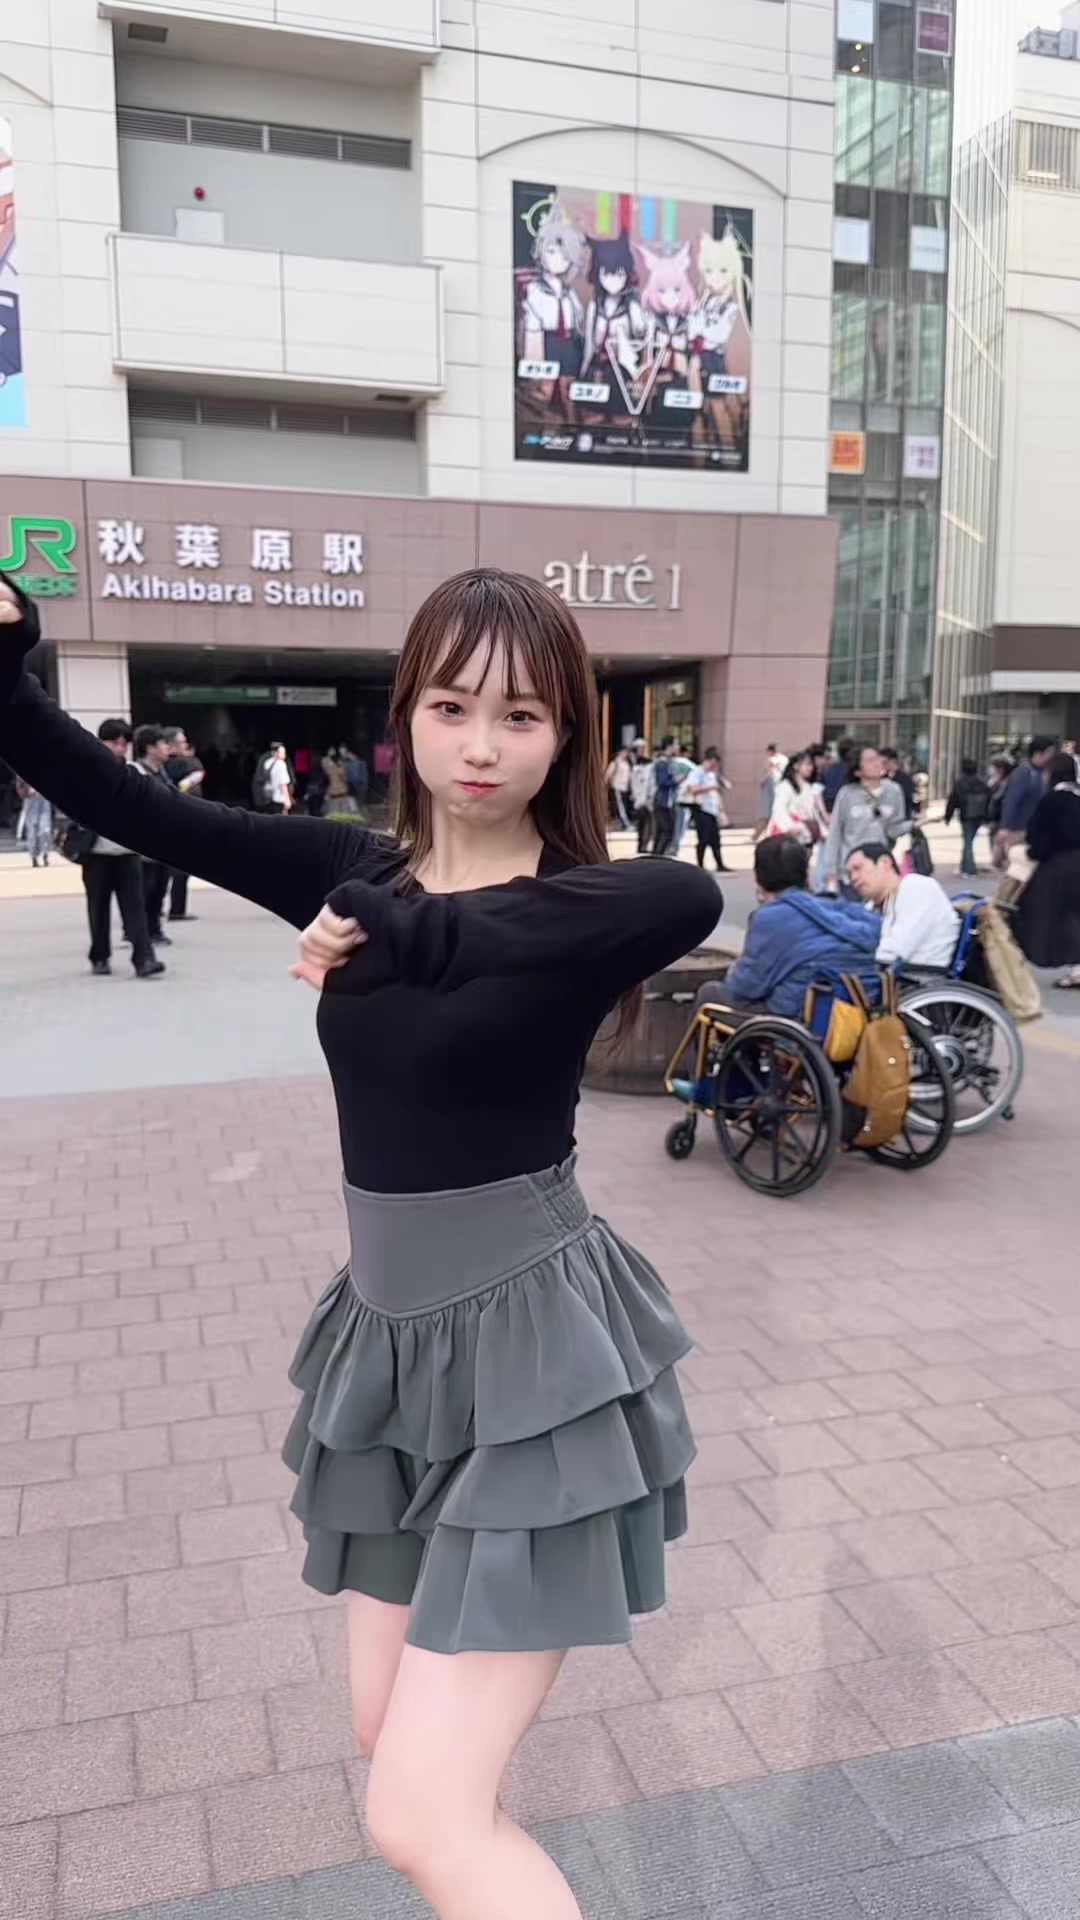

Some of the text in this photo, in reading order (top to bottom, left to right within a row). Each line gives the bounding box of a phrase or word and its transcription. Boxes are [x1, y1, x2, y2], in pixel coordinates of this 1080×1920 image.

[0, 515, 77, 573] JR
[98, 519, 364, 575] 秋葉原駅
[102, 572, 365, 608] Akihabara Station
[544, 551, 654, 605] atré
